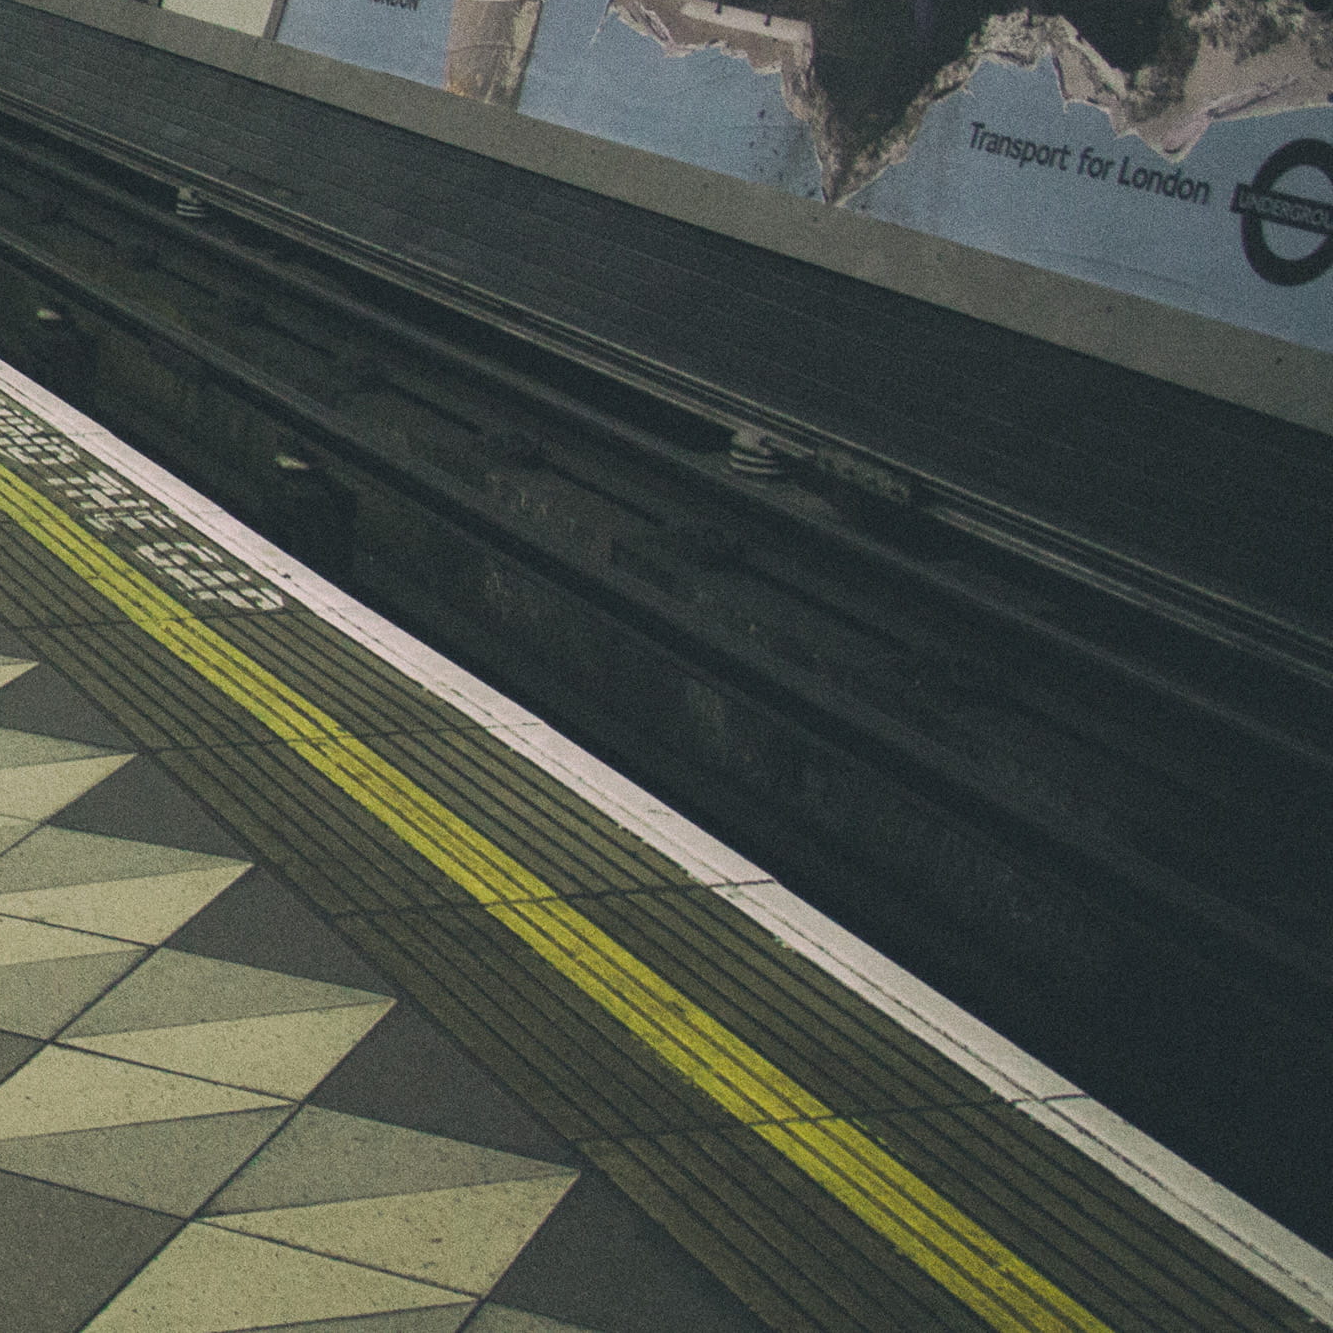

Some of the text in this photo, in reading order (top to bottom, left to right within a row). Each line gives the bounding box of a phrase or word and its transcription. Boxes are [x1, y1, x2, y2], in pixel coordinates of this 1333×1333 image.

[970, 121, 1211, 206] Transport for London
[46, 470, 178, 533] THE
[133, 540, 285, 612] GAP
